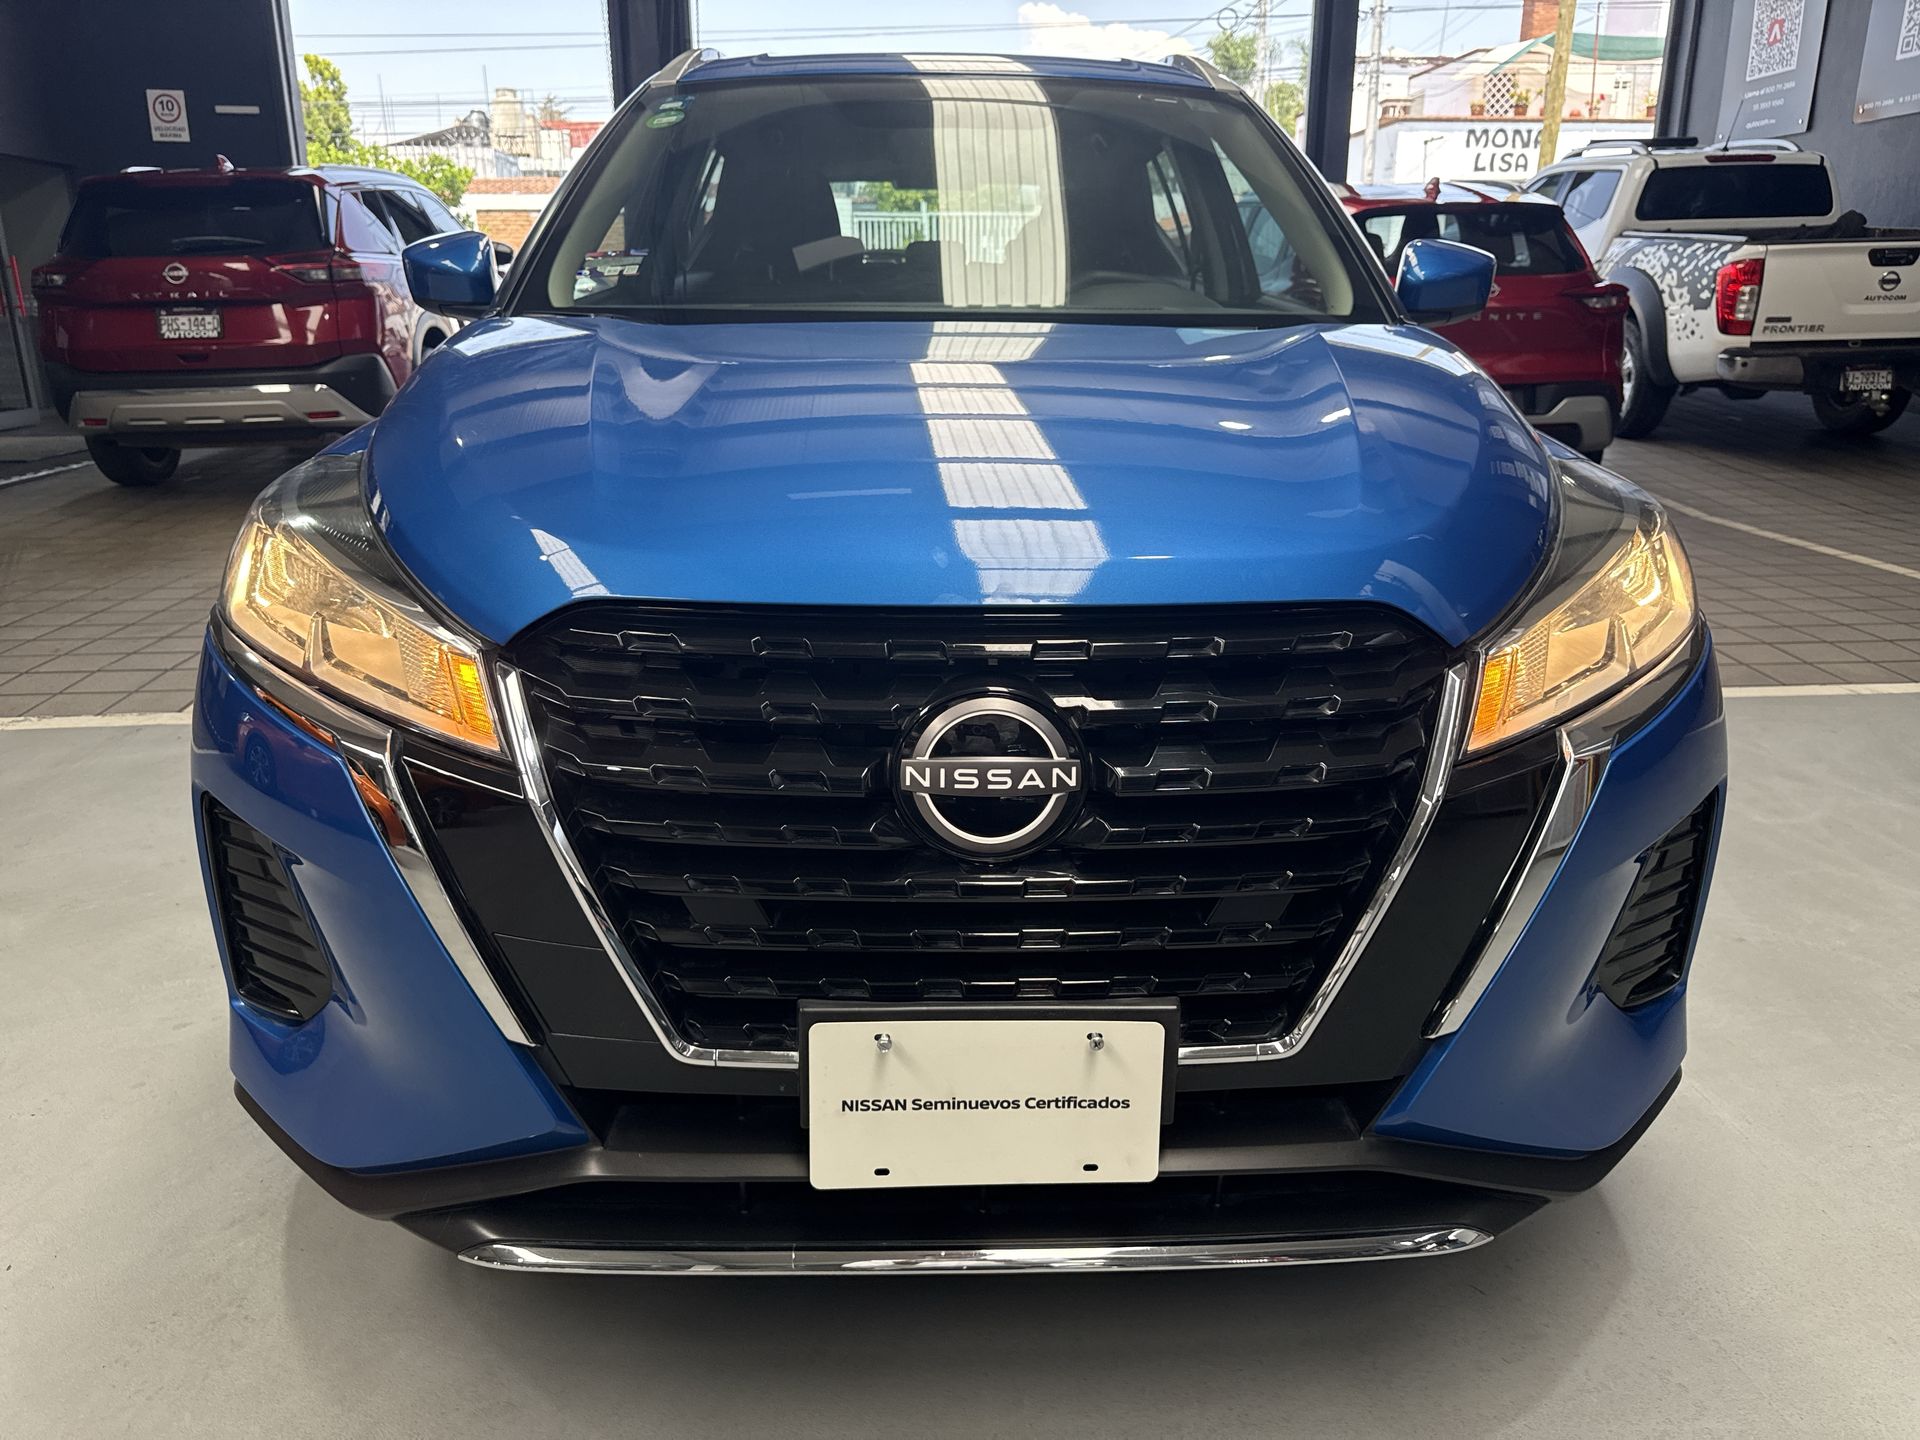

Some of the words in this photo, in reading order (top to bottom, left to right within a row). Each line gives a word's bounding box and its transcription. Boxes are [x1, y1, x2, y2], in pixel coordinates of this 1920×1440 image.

[158, 99, 174, 112] 10
[1473, 153, 1528, 172] LISA
[1863, 294, 1907, 302] AUTOCOM
[164, 329, 218, 339] AUTOCOM
[1762, 324, 1825, 335] FRONTIER
[1848, 382, 1892, 391] AUTOCOM
[905, 766, 1077, 790] NISSAN
[841, 1098, 907, 1113] NISSAN
[911, 1097, 1021, 1112] Seminuevos
[1024, 1096, 1131, 1111] Certificados
